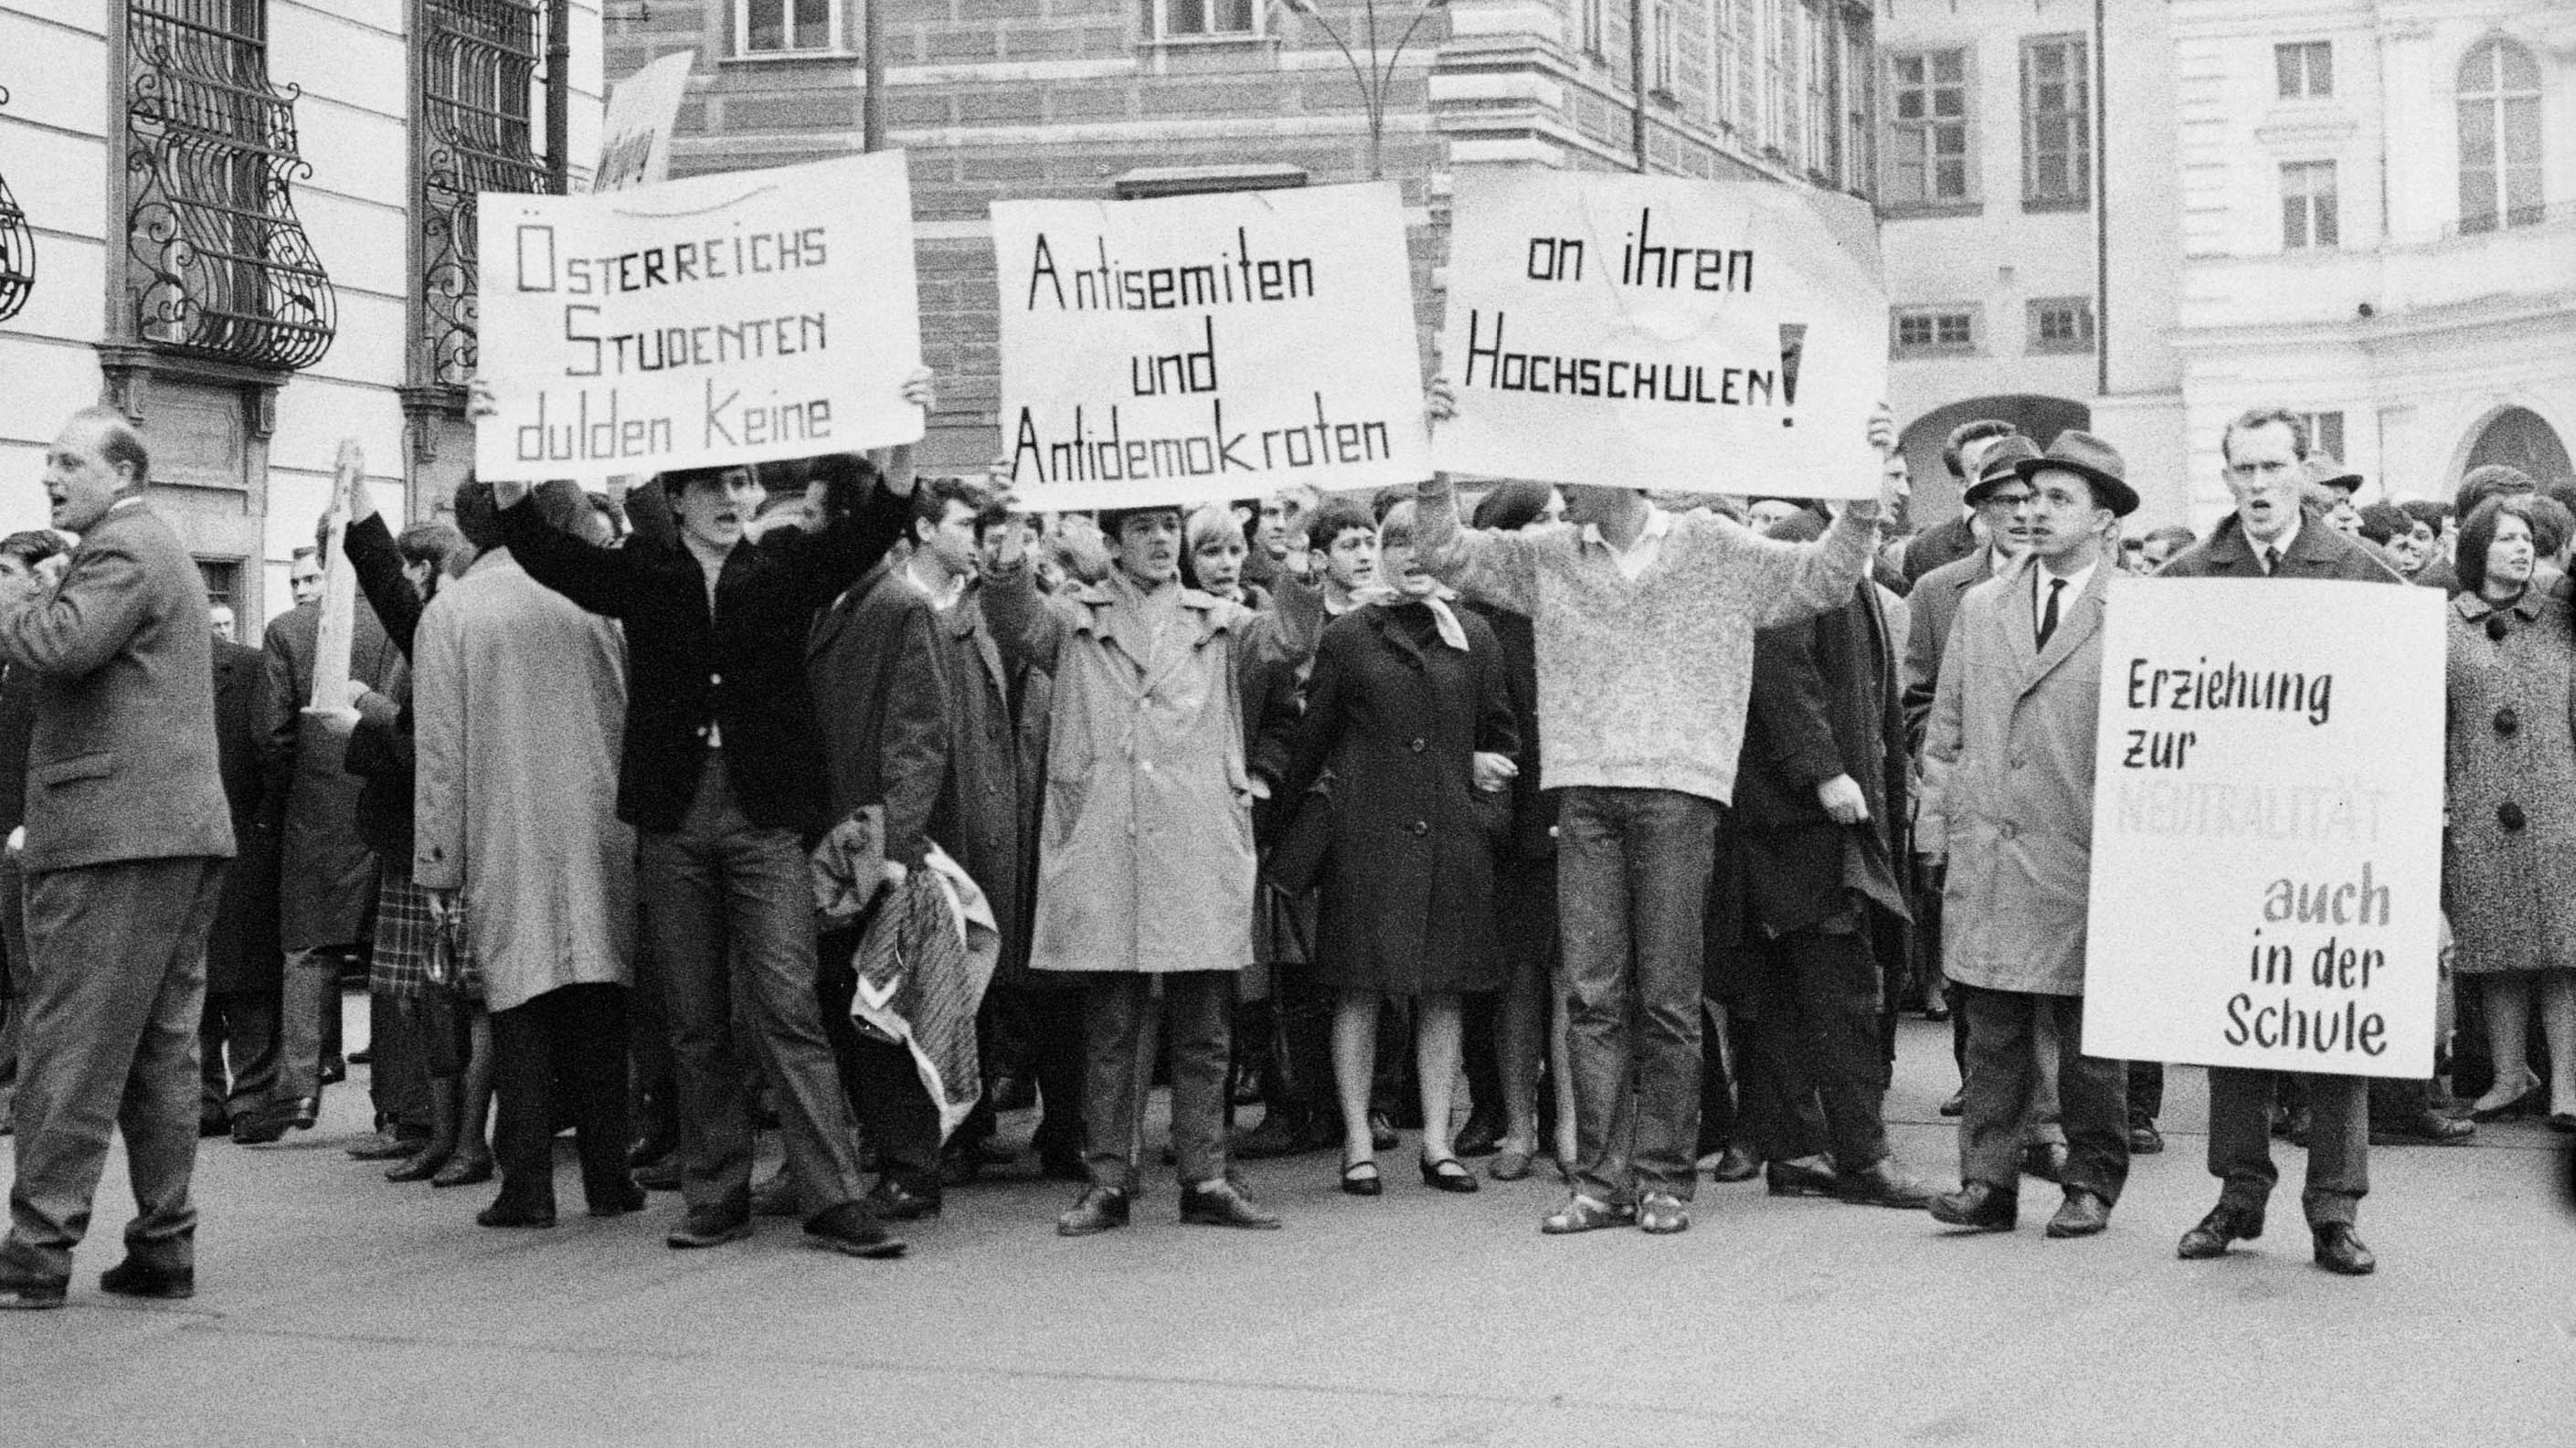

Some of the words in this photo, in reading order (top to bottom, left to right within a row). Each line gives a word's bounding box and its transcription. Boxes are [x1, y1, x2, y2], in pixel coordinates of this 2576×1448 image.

[1028, 226, 1314, 311] Antisemiten
[1622, 206, 1754, 293] ihren
[1131, 314, 1218, 396] und
[517, 388, 672, 461] dulden
[705, 378, 832, 448] Keine
[2127, 656, 2333, 727] Erziehung
[2122, 728, 2197, 770] zur
[2263, 862, 2390, 926] auch
[2250, 927, 2293, 985] in
[2311, 935, 2386, 989] der
[2223, 992, 2388, 1058] Schule
